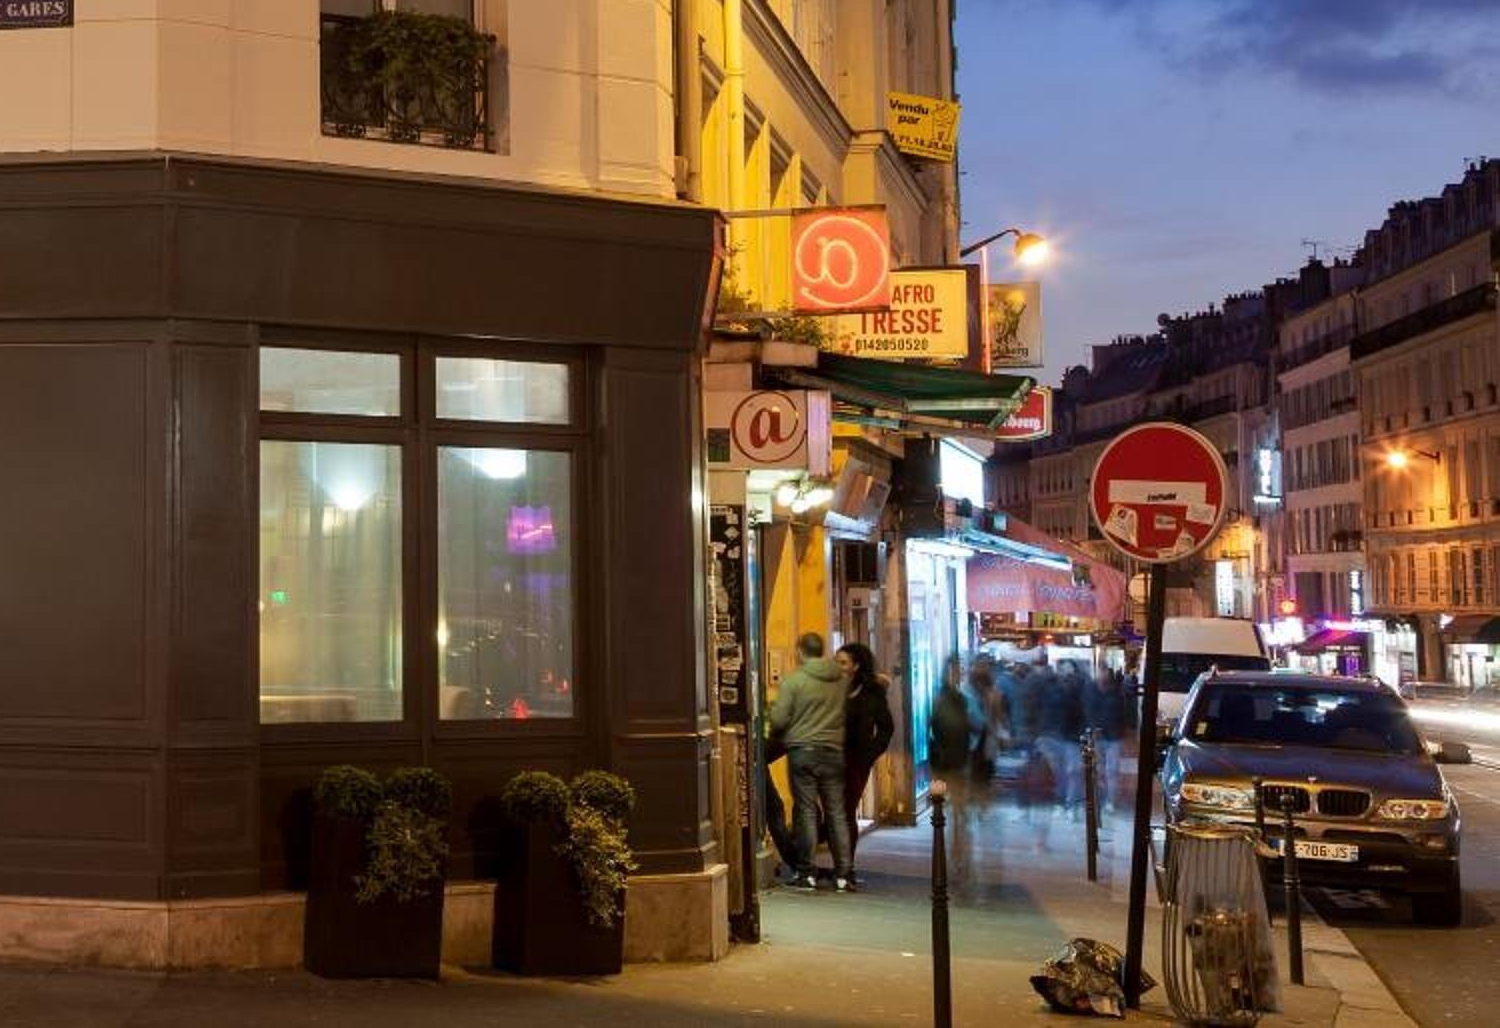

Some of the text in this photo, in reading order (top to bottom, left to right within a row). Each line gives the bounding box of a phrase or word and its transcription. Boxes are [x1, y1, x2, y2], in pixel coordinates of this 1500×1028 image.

[7, 1, 65, 17] GARES
[889, 98, 929, 115] Vendu
[898, 115, 920, 124] par
[892, 284, 935, 304] AFRO
[860, 308, 943, 335] TRESSE
[731, 391, 807, 463] @
